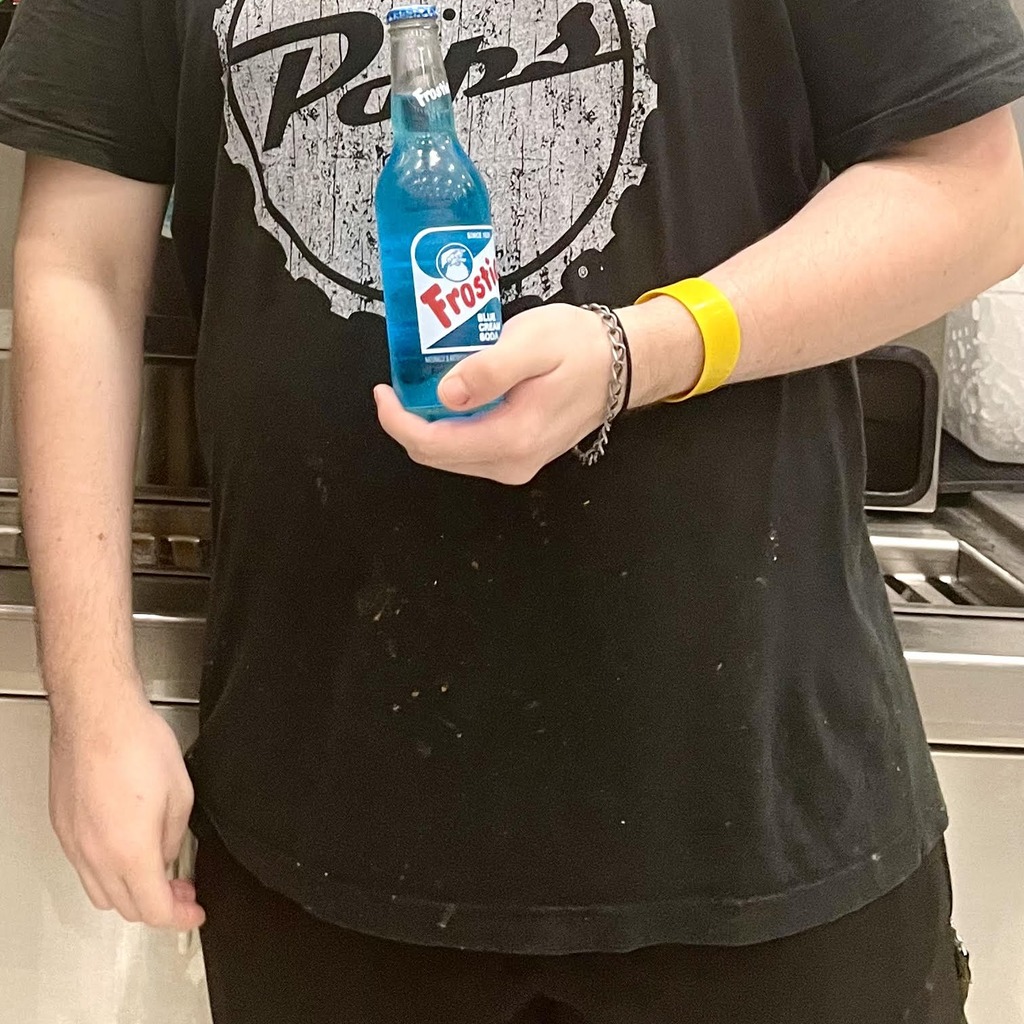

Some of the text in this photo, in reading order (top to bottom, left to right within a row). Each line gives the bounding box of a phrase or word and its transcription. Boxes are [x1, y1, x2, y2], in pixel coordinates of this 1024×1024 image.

[229, 1, 626, 153] Pops
[412, 80, 451, 107] Frosti
[420, 257, 499, 329] Frosti
